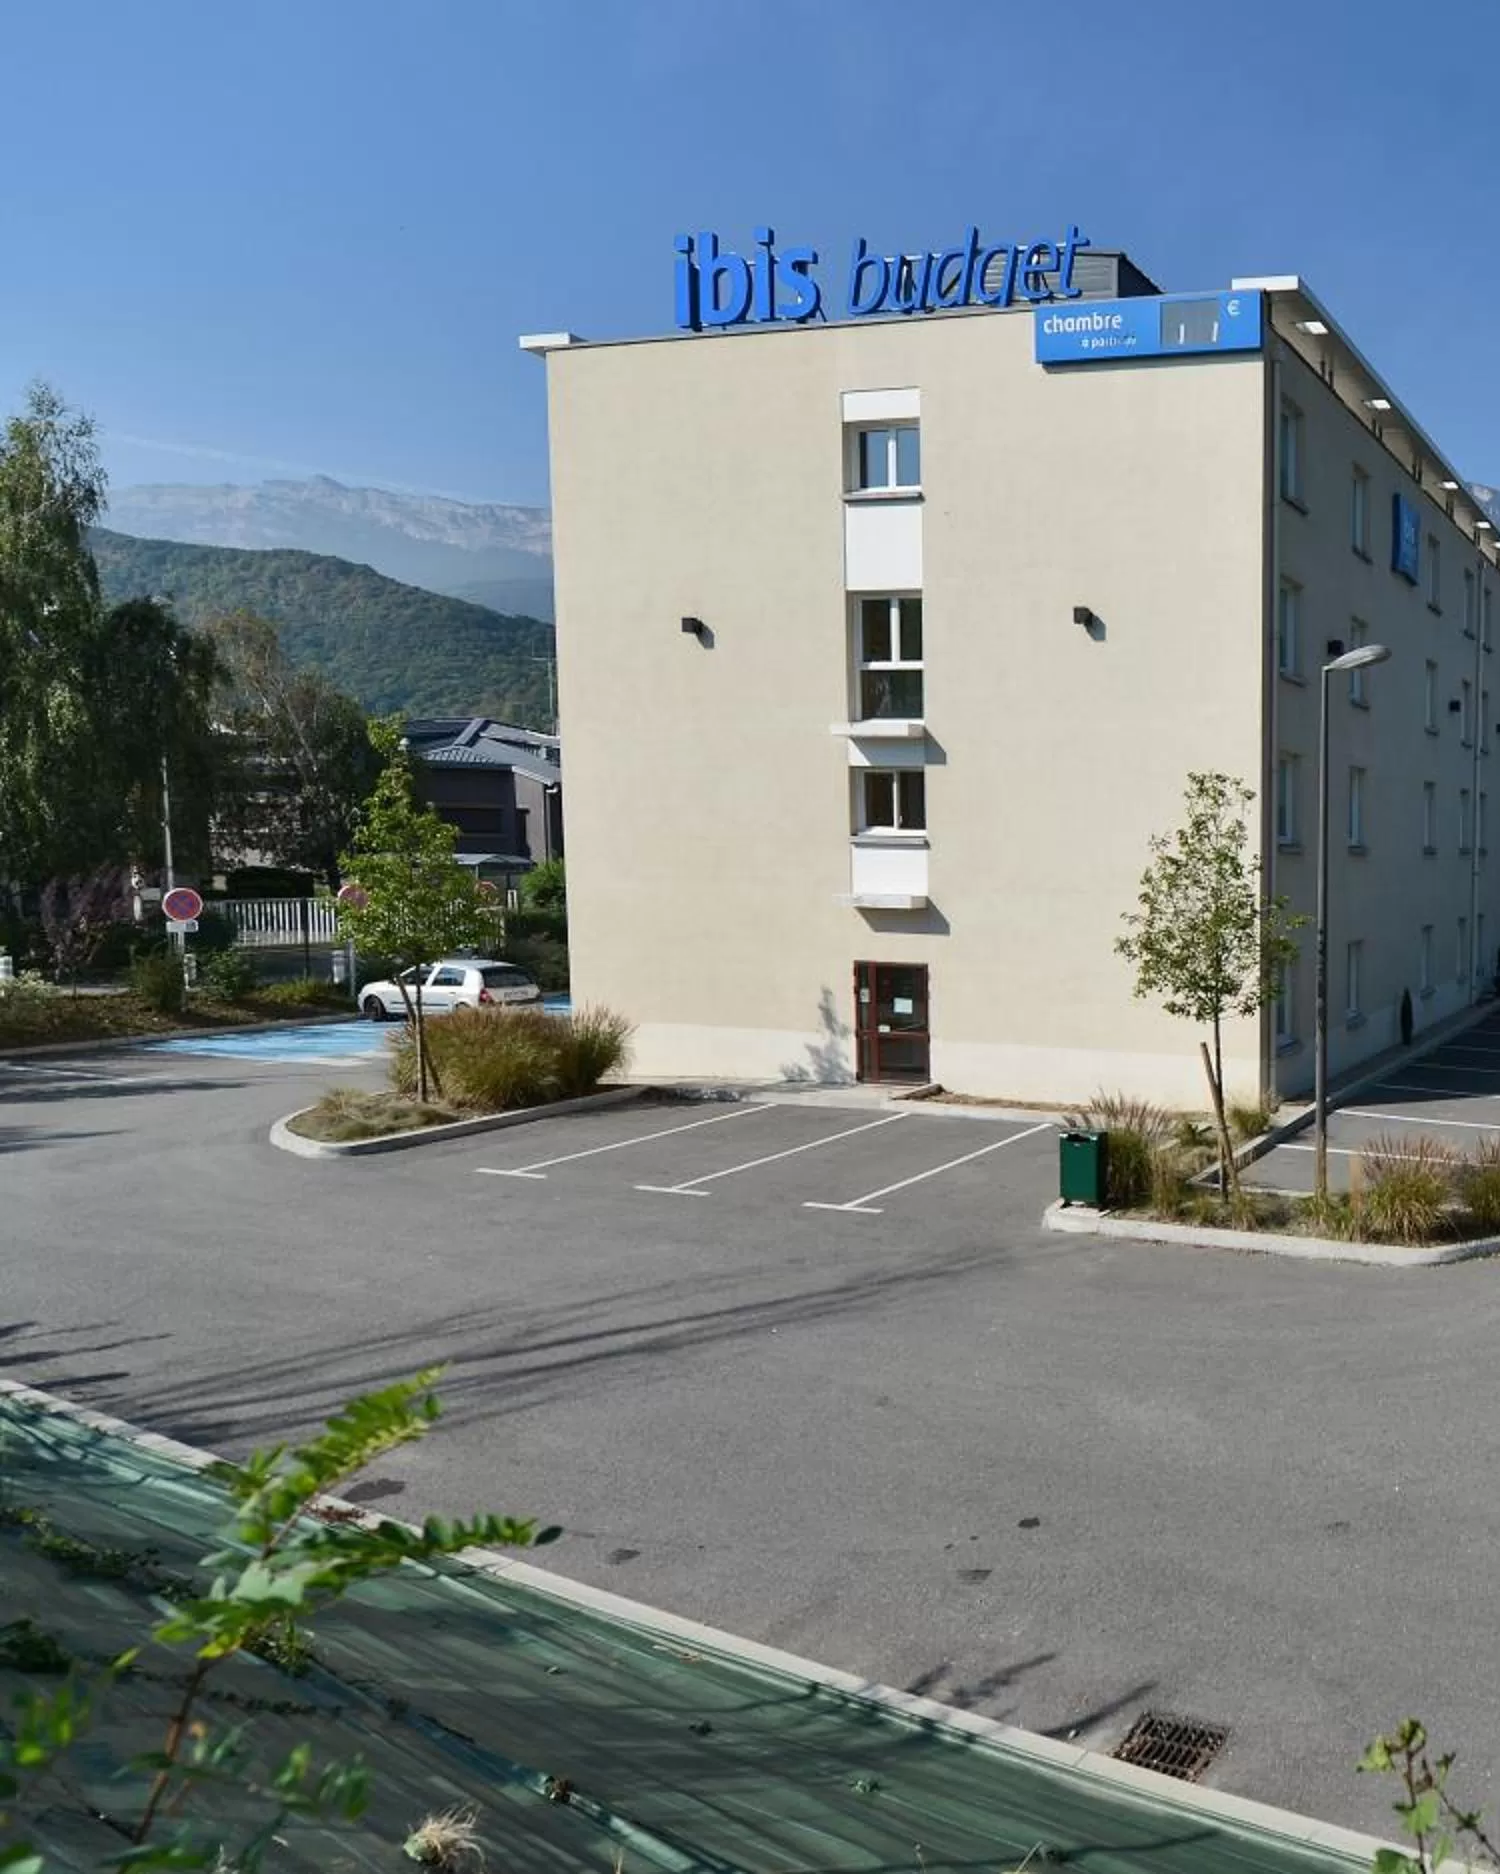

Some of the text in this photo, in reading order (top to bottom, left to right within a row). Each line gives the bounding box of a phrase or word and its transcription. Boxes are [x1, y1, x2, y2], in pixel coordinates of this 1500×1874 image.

[674, 223, 1090, 330] ibis budget
[1043, 311, 1122, 334] chambre
